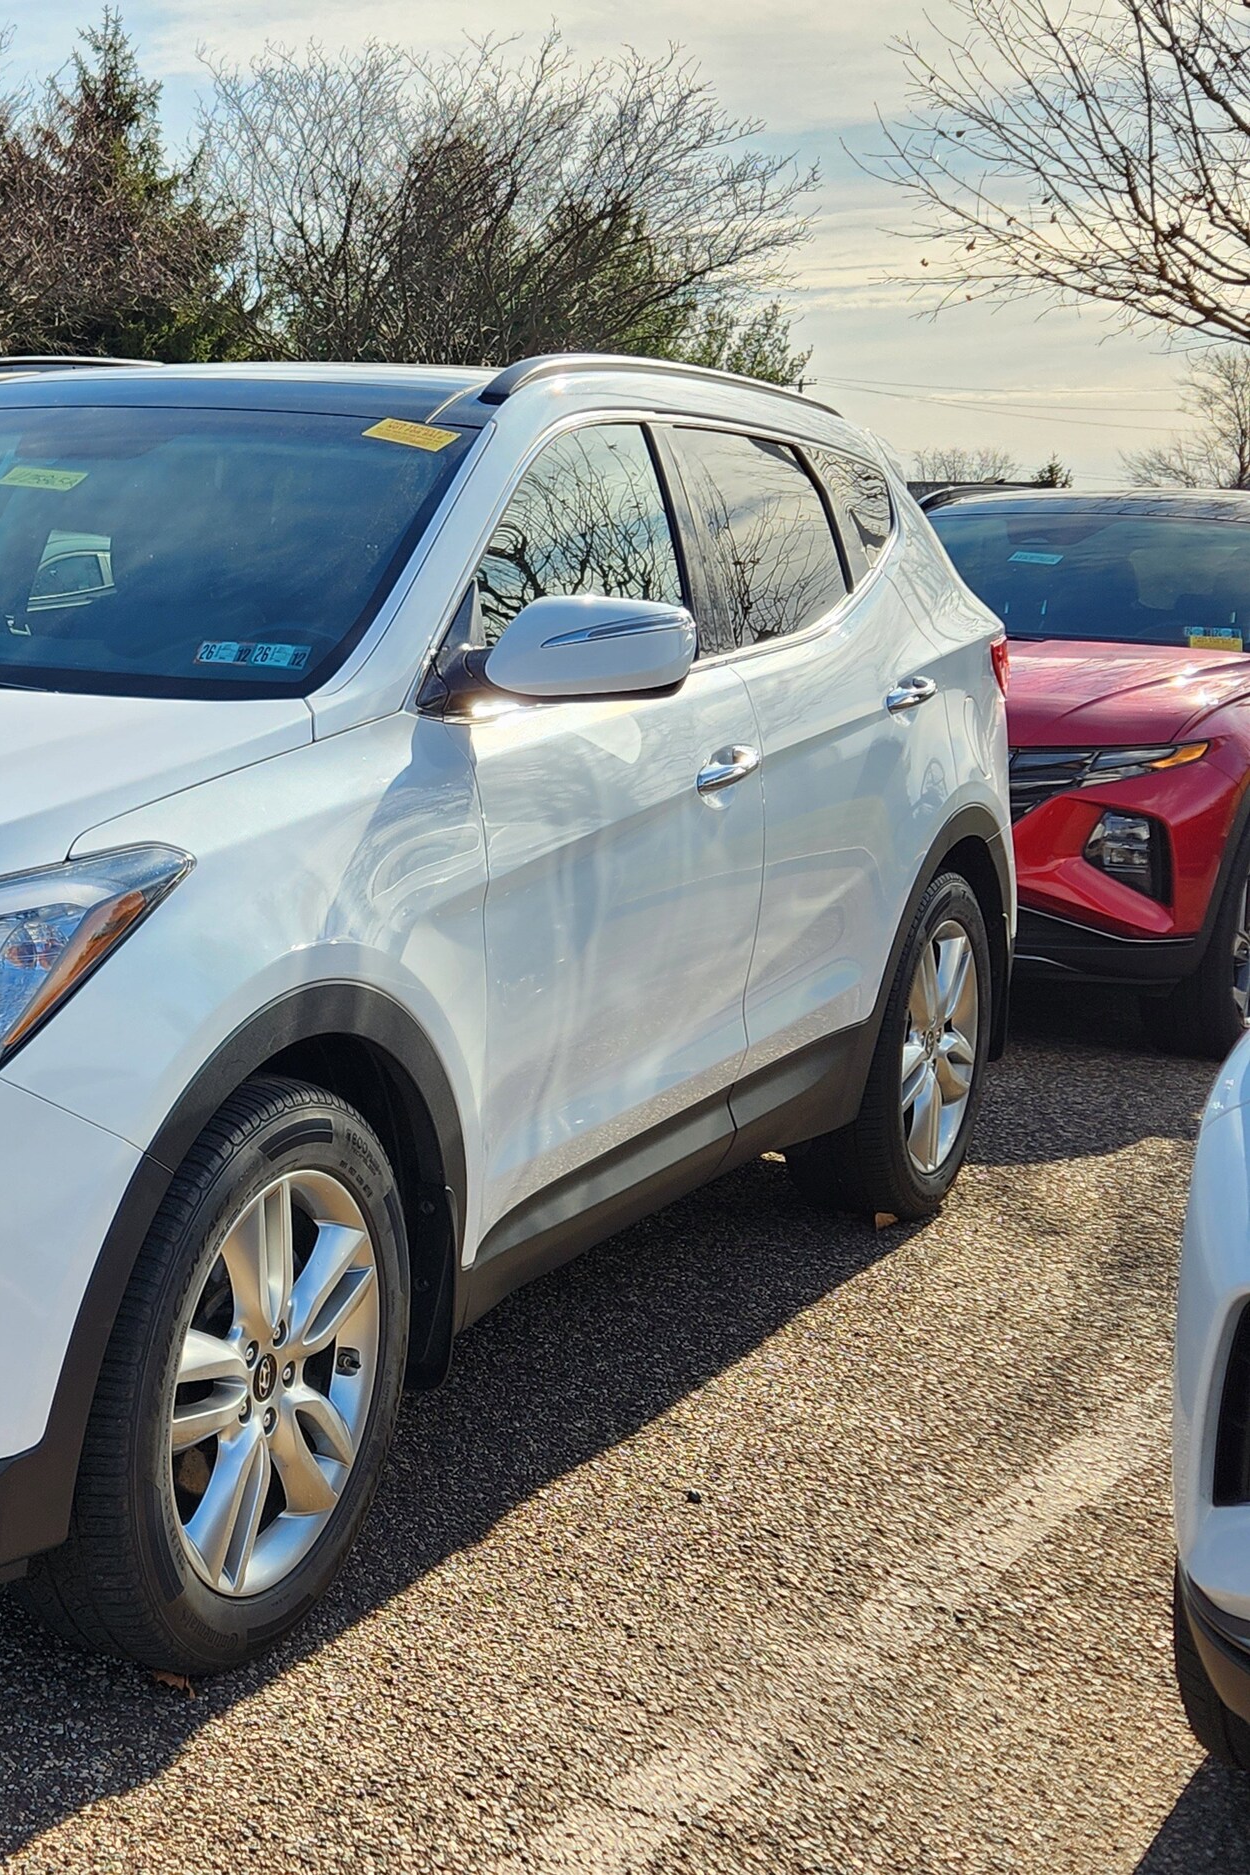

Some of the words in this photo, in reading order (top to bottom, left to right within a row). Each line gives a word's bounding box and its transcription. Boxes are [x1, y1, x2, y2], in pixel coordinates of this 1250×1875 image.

[199, 644, 216, 660] 26
[233, 648, 252, 662] 12
[253, 646, 272, 662] 26
[290, 652, 307, 666] 12
